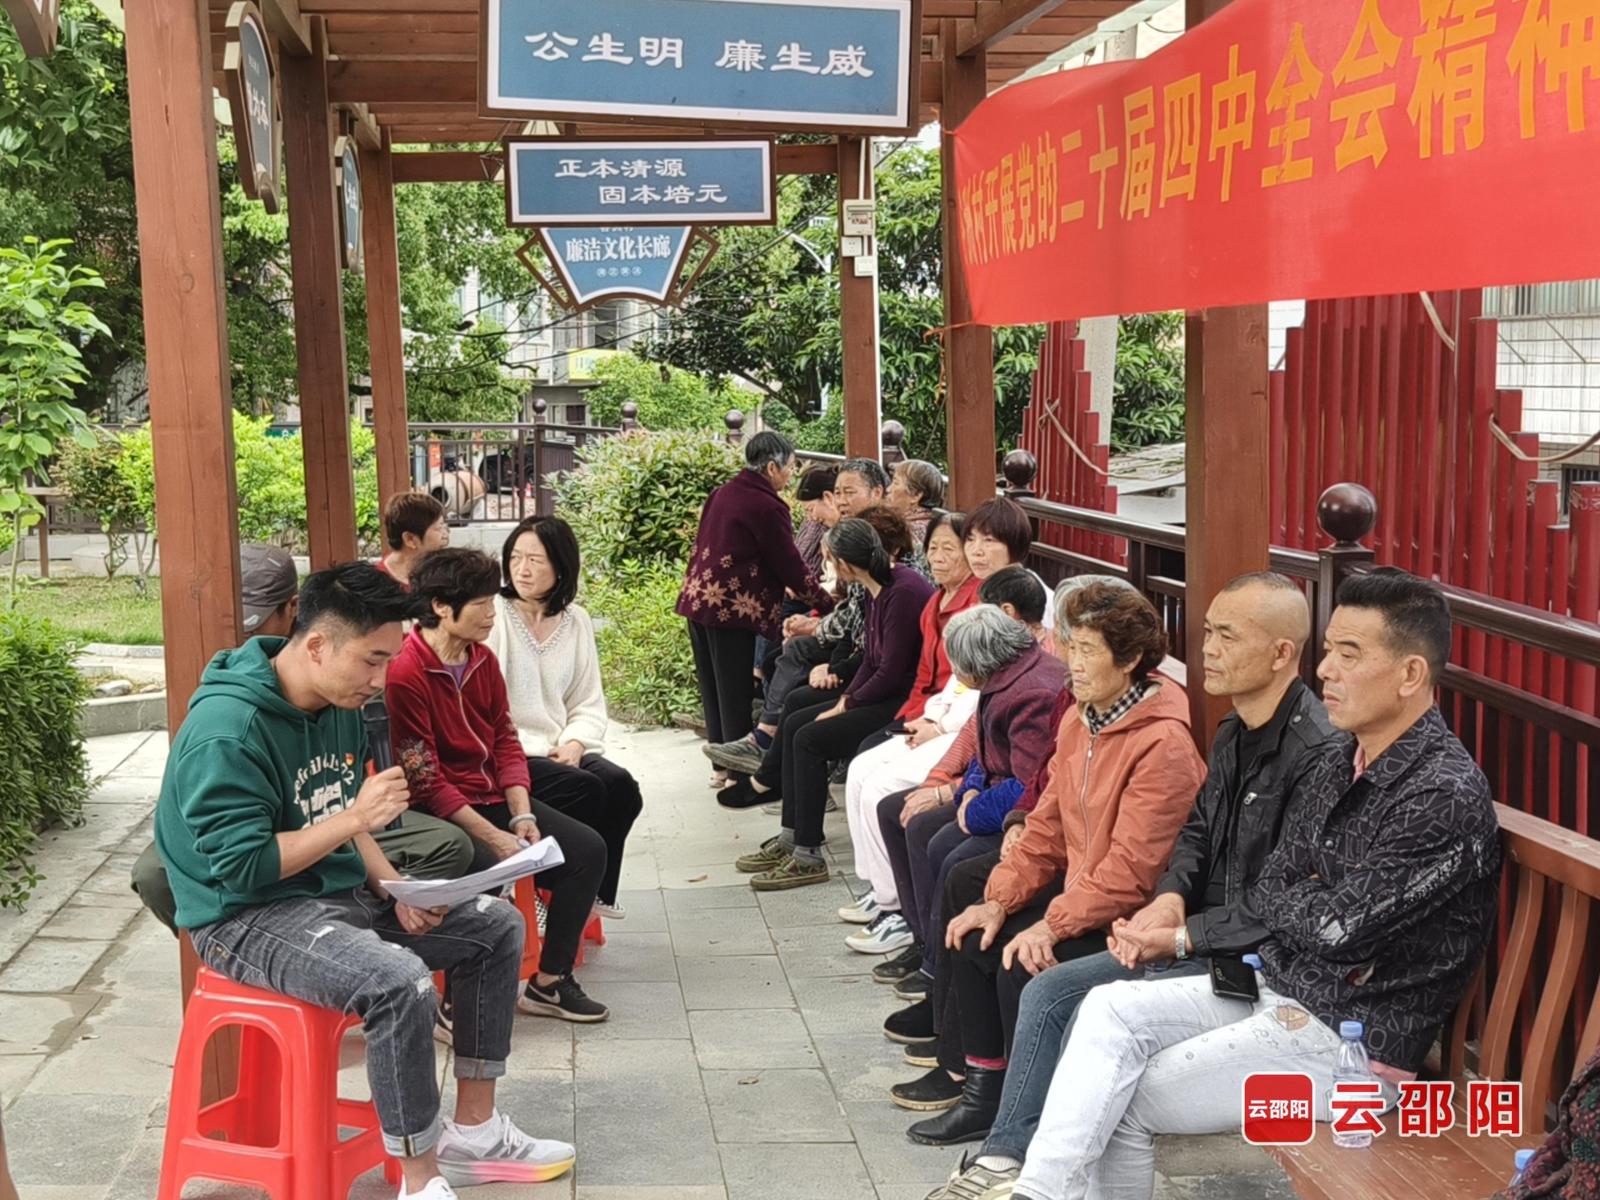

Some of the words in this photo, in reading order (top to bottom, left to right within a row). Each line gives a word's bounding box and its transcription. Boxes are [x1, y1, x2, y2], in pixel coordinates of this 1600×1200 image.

[524, 31, 684, 69] 公生明
[715, 39, 874, 78] 廉生威
[554, 157, 687, 179] 正本清源
[599, 184, 728, 205] 固本培元
[565, 234, 671, 262] 廉洁文化长廊
